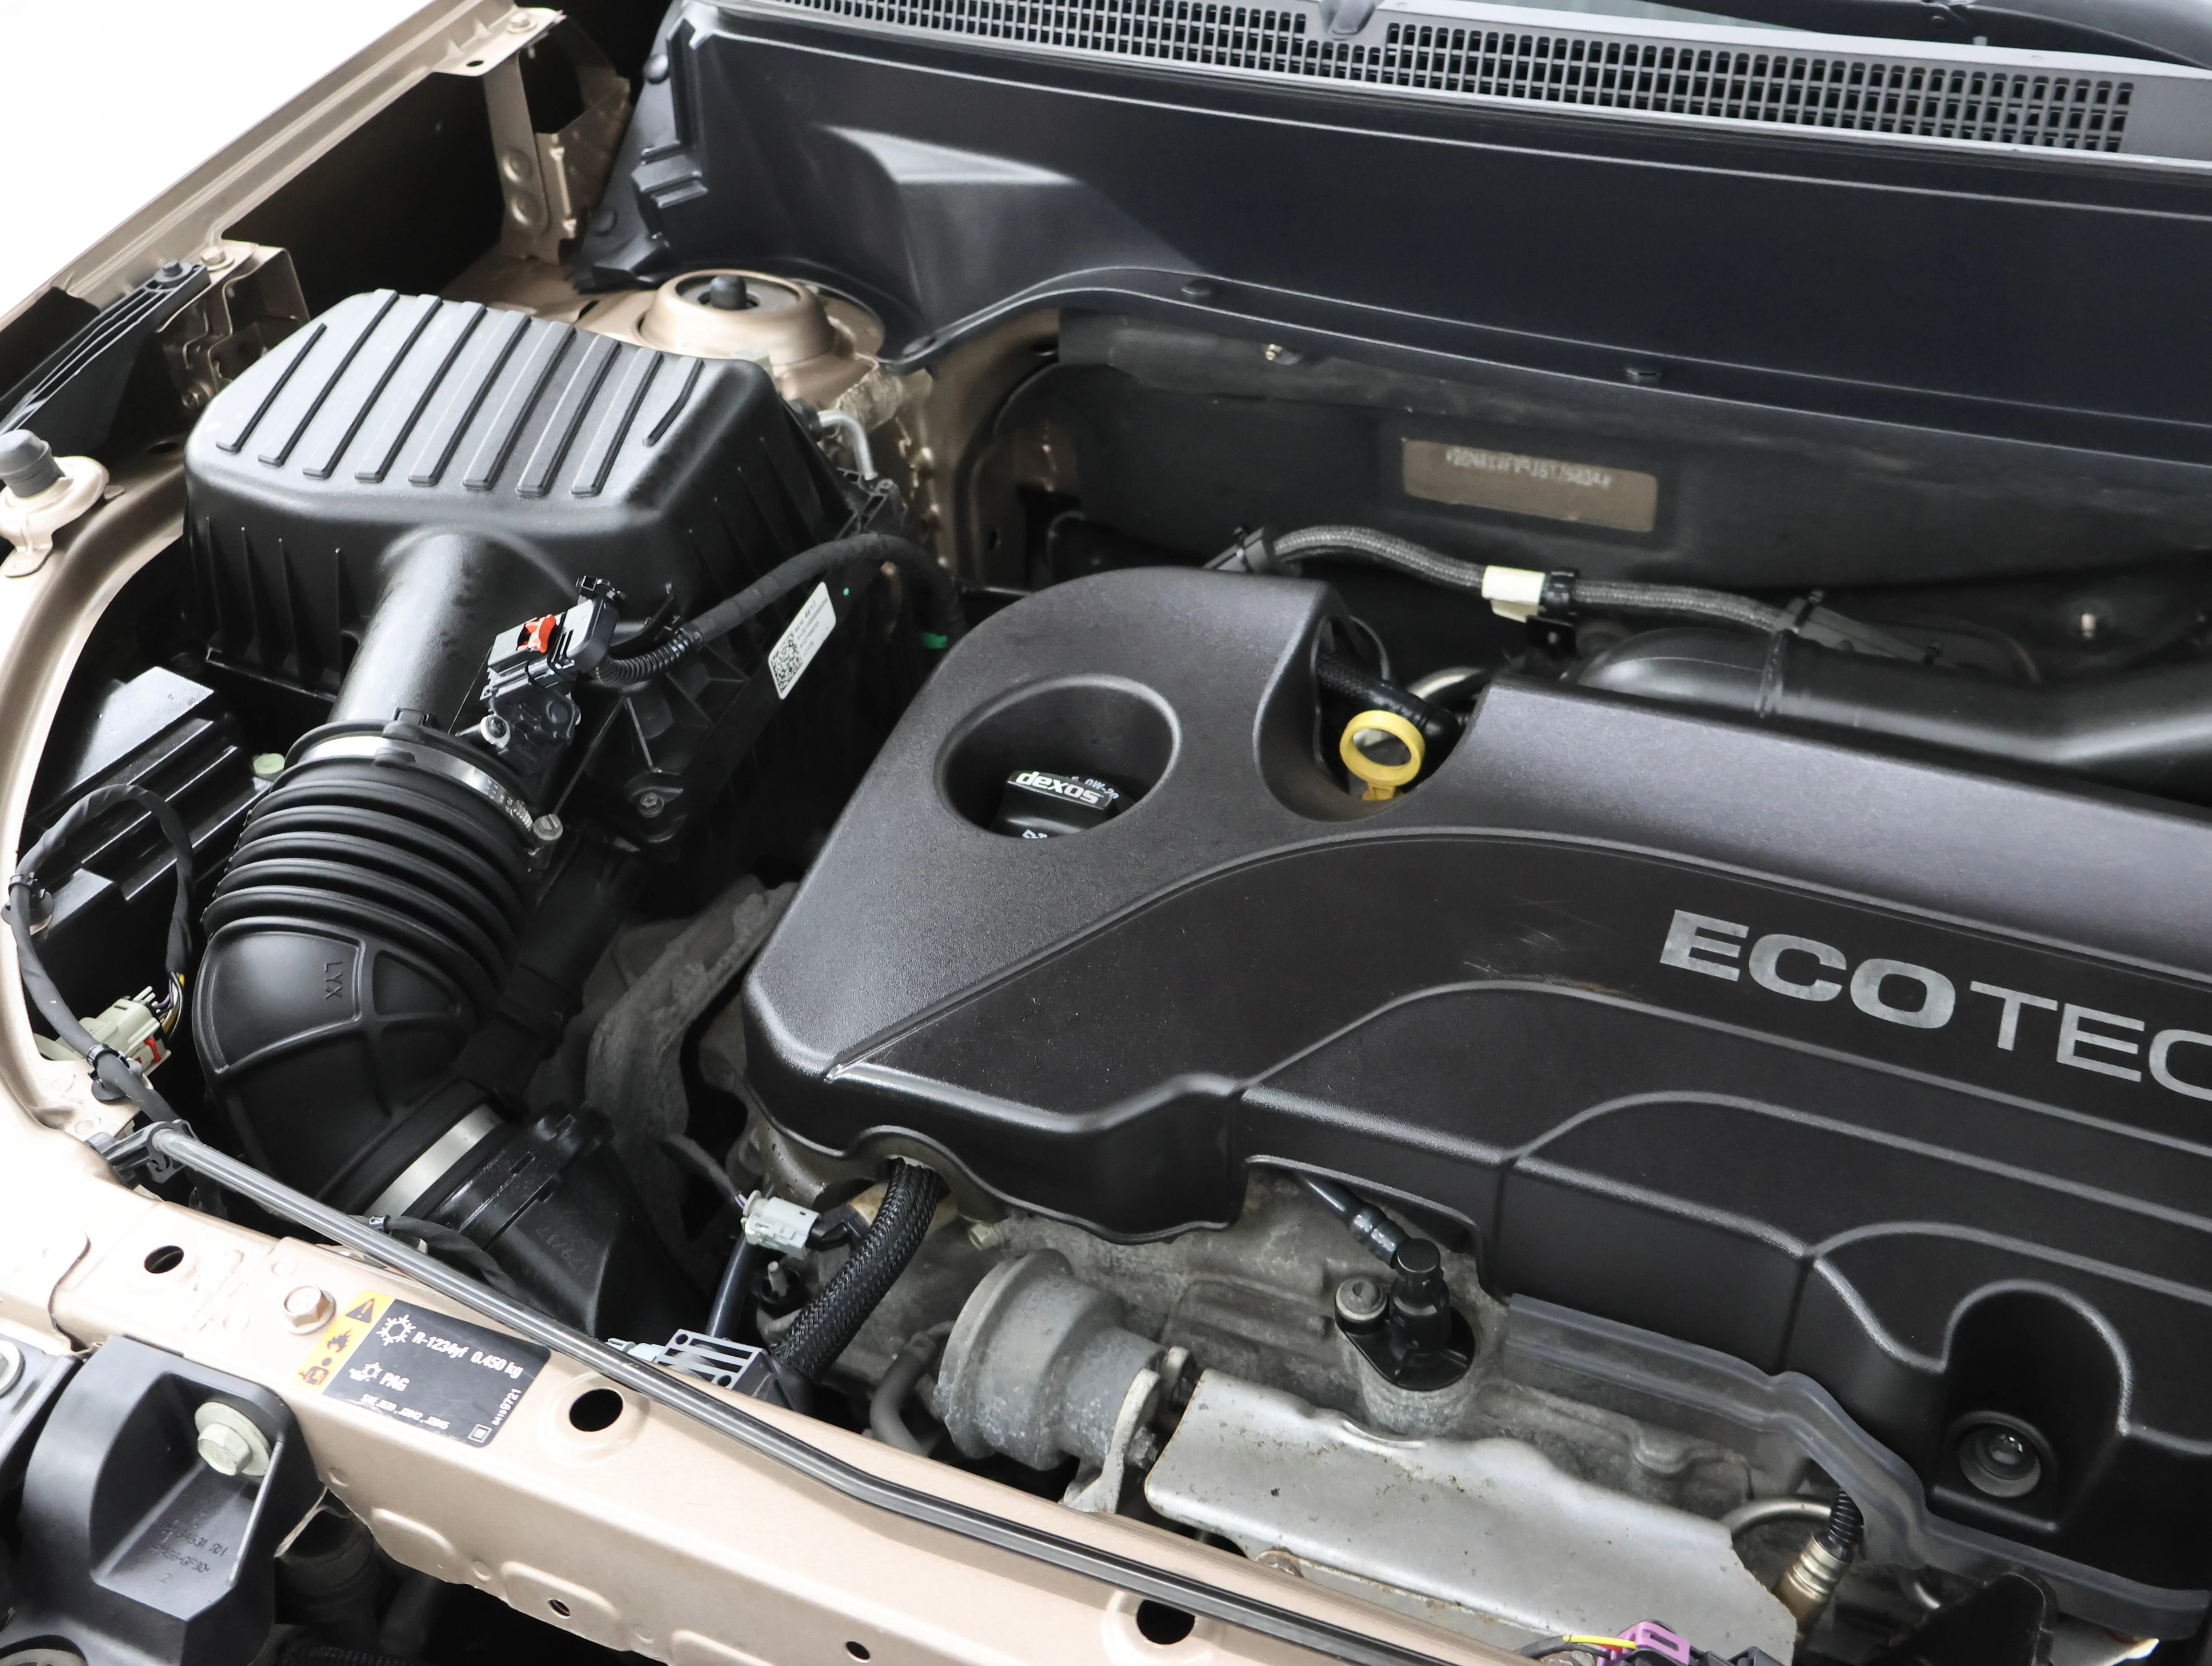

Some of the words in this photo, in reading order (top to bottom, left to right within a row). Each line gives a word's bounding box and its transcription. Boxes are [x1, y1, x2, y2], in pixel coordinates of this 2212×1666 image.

[1016, 771, 1103, 804] dexos
[325, 961, 343, 1000] LYX
[1660, 909, 2212, 1101] ECOTEC
[412, 1331, 469, 1358] R-1234yf
[471, 1351, 507, 1371] 0.450
[504, 1362, 524, 1379] kg
[379, 1372, 410, 1391] PAG
